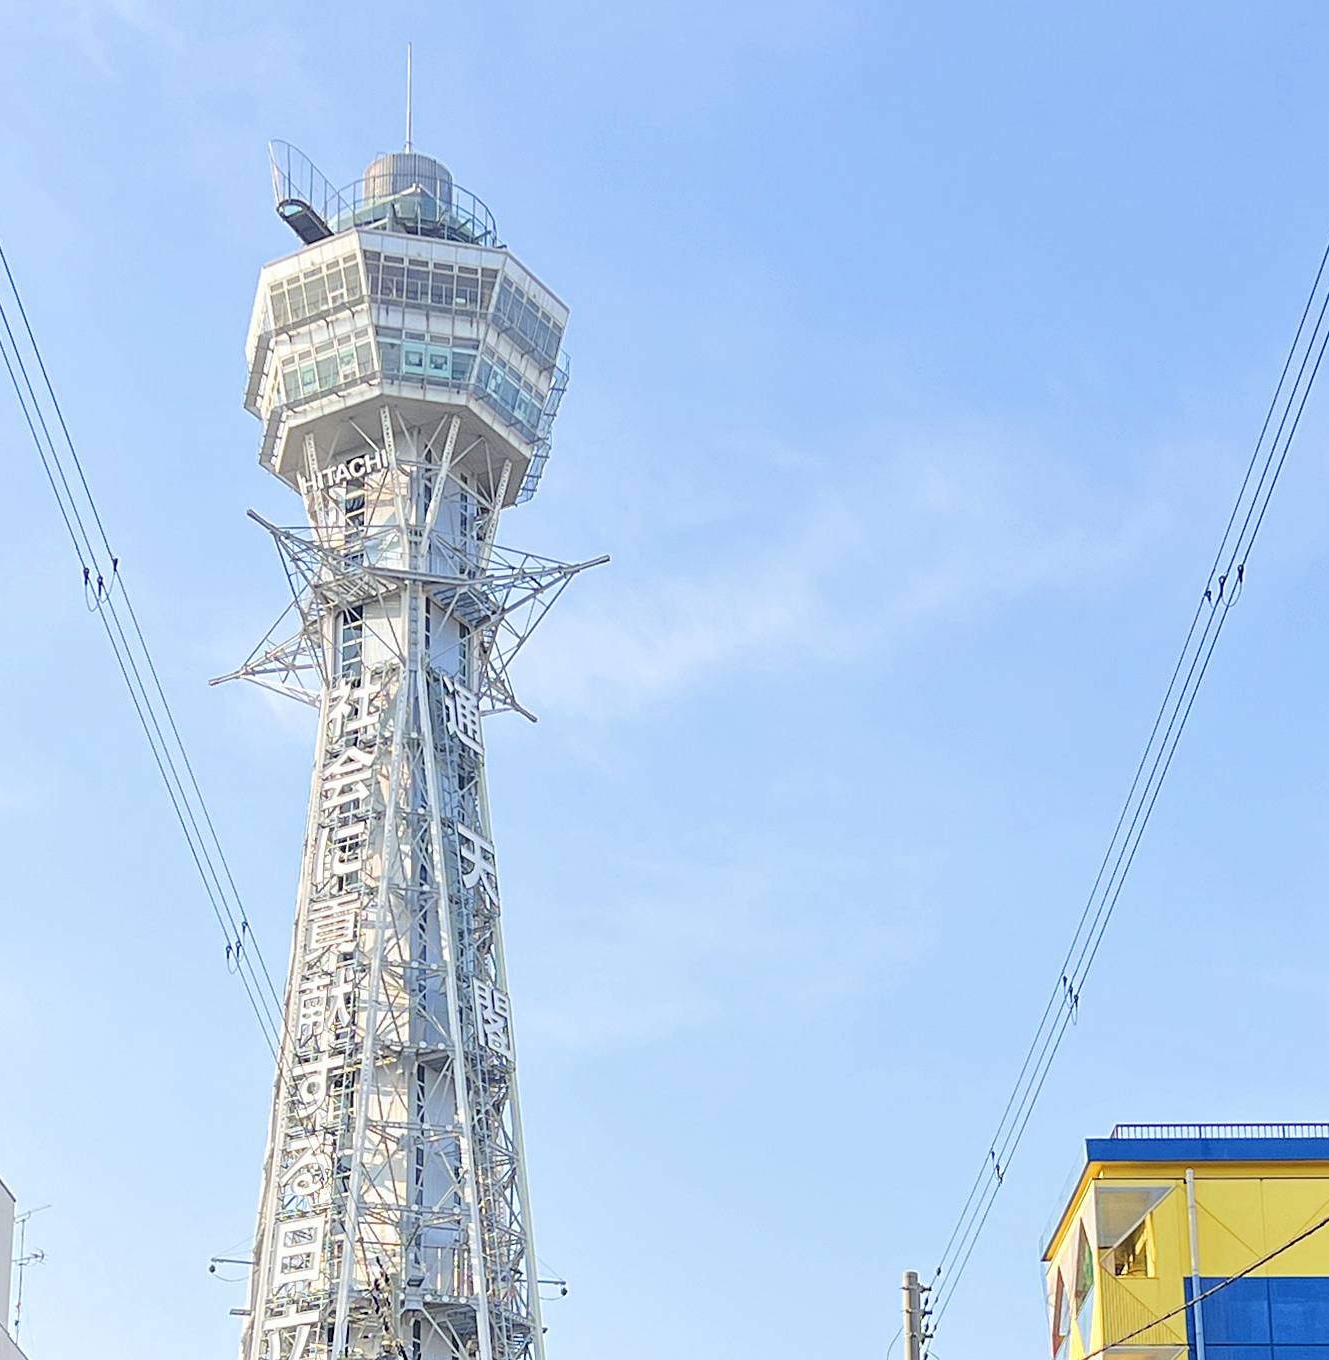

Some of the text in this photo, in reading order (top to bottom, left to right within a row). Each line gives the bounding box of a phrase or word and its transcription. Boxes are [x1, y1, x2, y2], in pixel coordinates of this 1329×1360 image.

[296, 448, 389, 494] HITACHI
[443, 675, 514, 1061] 通天閣
